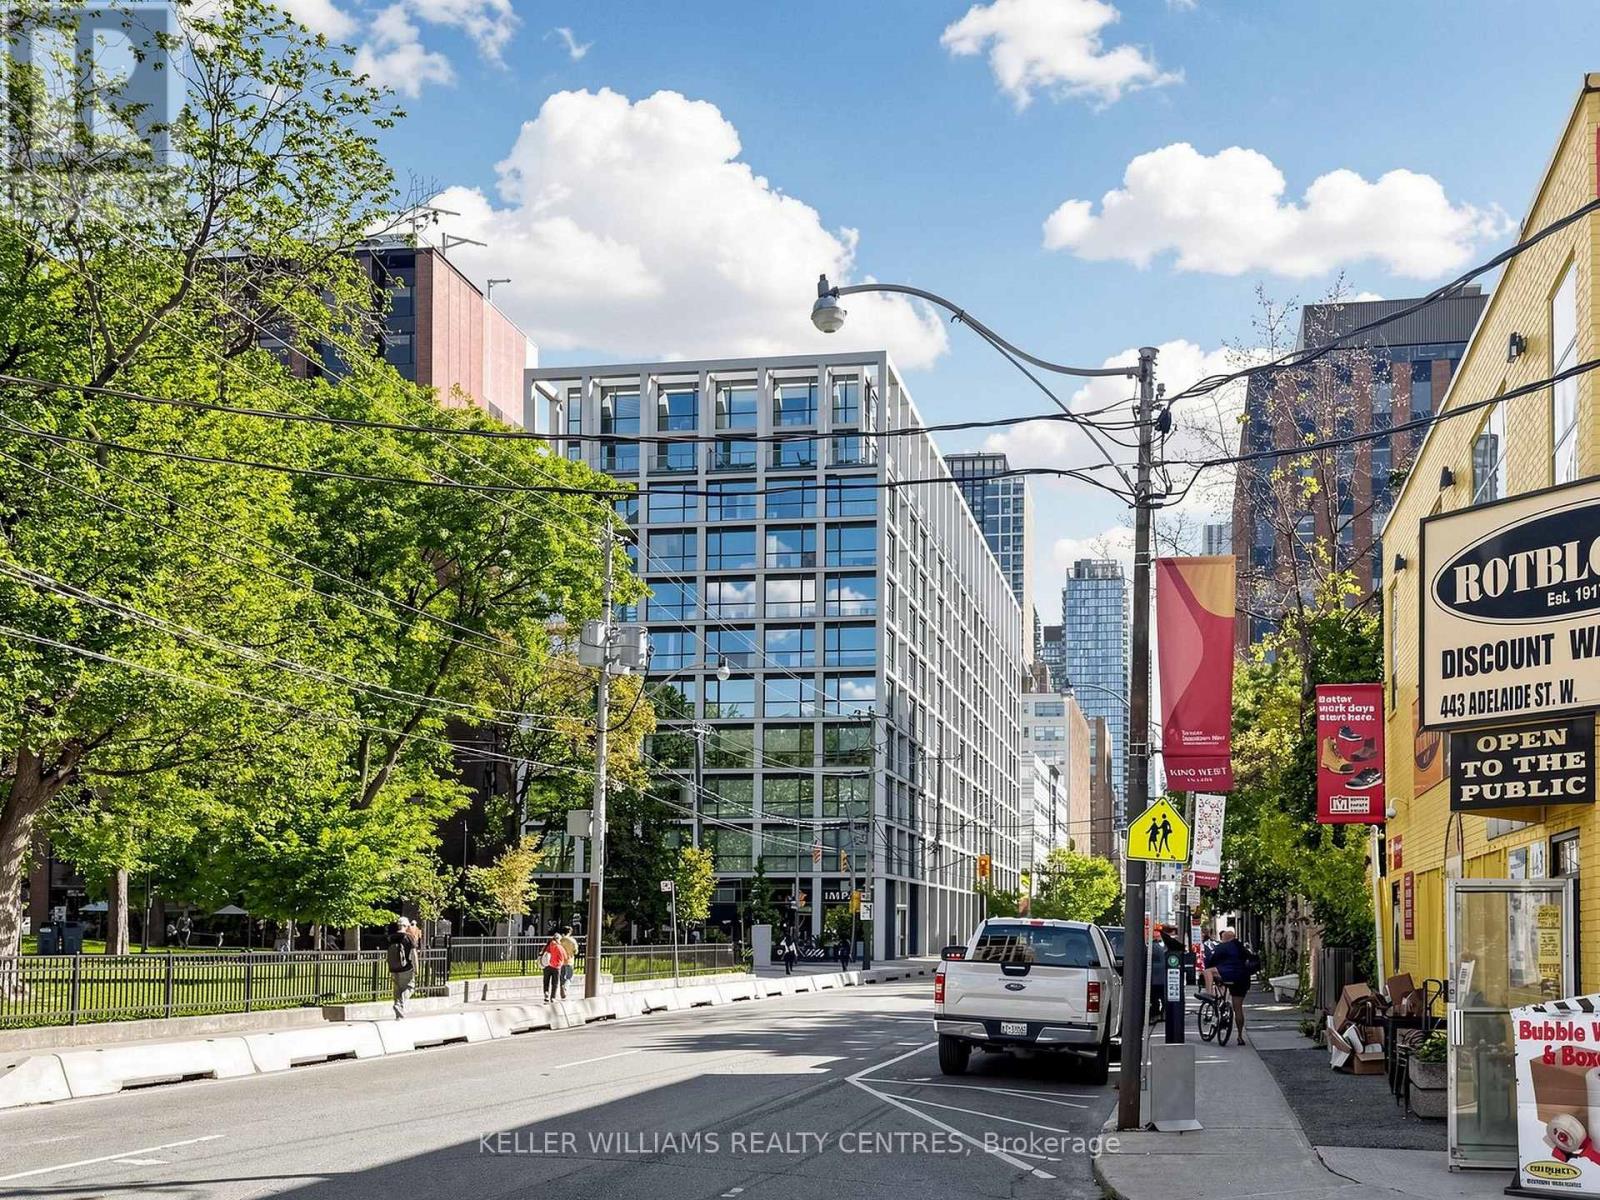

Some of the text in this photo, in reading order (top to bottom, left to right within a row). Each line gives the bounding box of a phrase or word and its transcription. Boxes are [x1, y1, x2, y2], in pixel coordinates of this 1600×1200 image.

[1547, 583, 1600, 607] Est. 191
[1442, 633, 1555, 679] DISCOUNT
[1440, 678, 1578, 718] 443 ADELAIDE ST. W.
[1476, 728, 1568, 752] OPEN
[1460, 751, 1586, 778] TO THE
[1460, 776, 1586, 801] PUBLIC
[1519, 1020, 1585, 1042] Bubble
[1543, 1045, 1600, 1067] & Box
